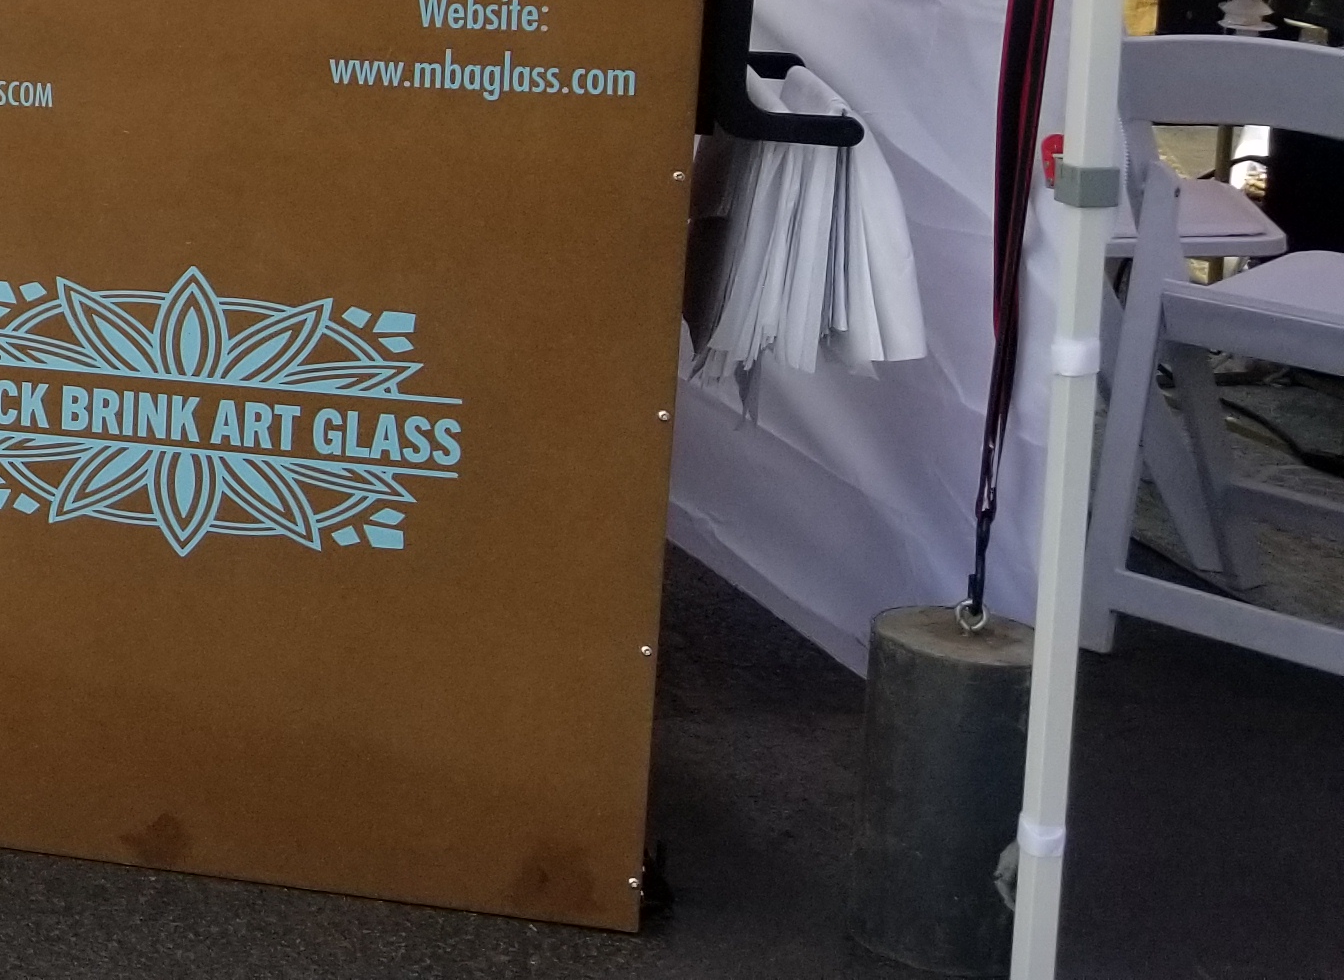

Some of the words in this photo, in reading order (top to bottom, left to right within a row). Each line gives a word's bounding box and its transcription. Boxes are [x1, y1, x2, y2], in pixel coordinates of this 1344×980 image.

[329, 48, 636, 101] www.mbaglass.com
[61, 385, 200, 442] BRINK
[210, 399, 302, 451] ART
[313, 408, 462, 466] GLASS
